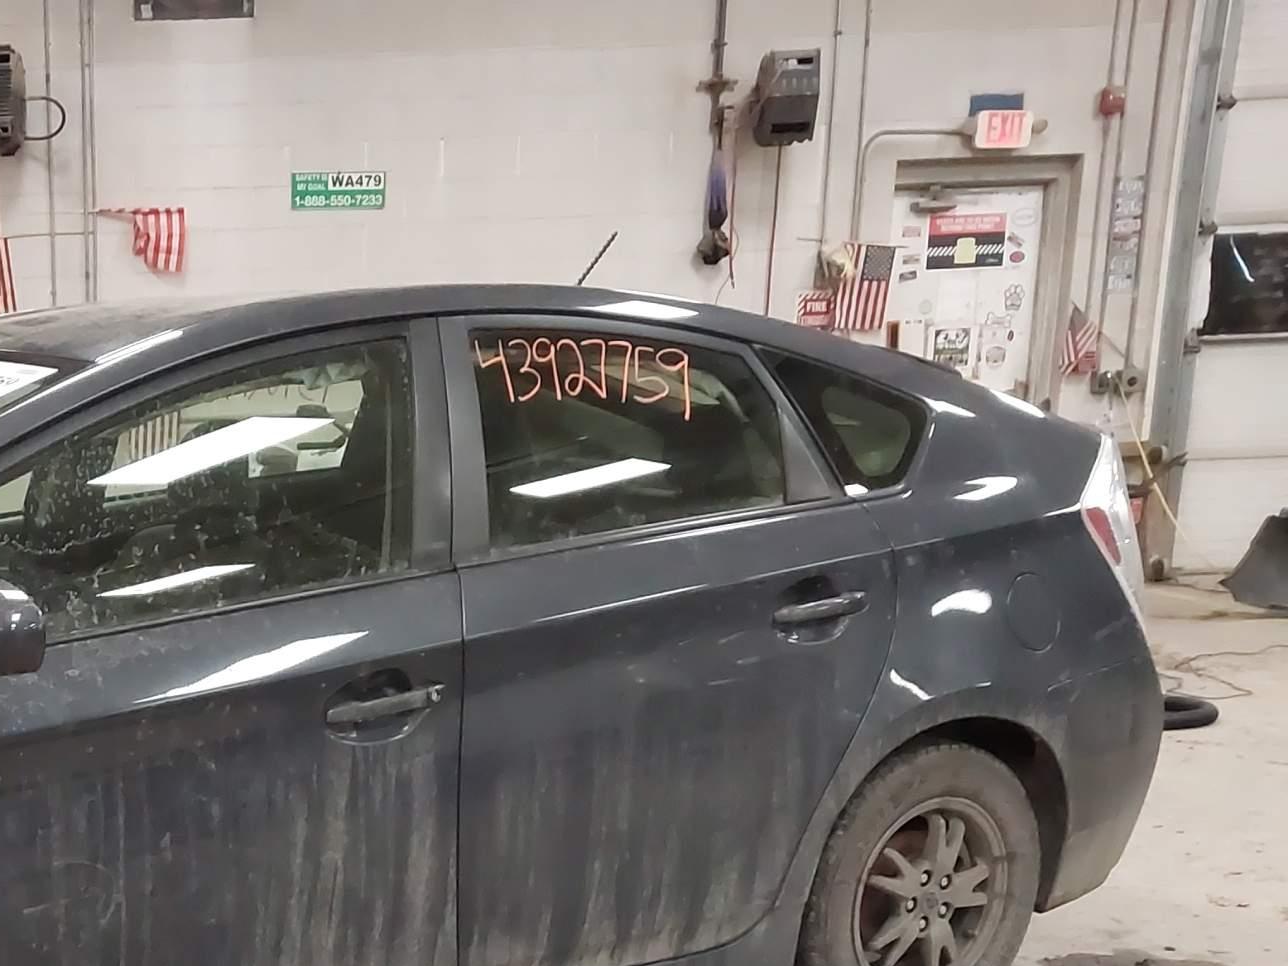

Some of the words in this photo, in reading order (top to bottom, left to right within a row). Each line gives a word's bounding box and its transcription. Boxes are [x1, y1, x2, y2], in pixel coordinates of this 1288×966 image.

[986, 111, 1027, 144] EXIT
[331, 175, 382, 187] WA479
[294, 195, 383, 206] 1-888-550-7233
[806, 301, 828, 313] FIRE
[474, 337, 691, 421] 43927759
